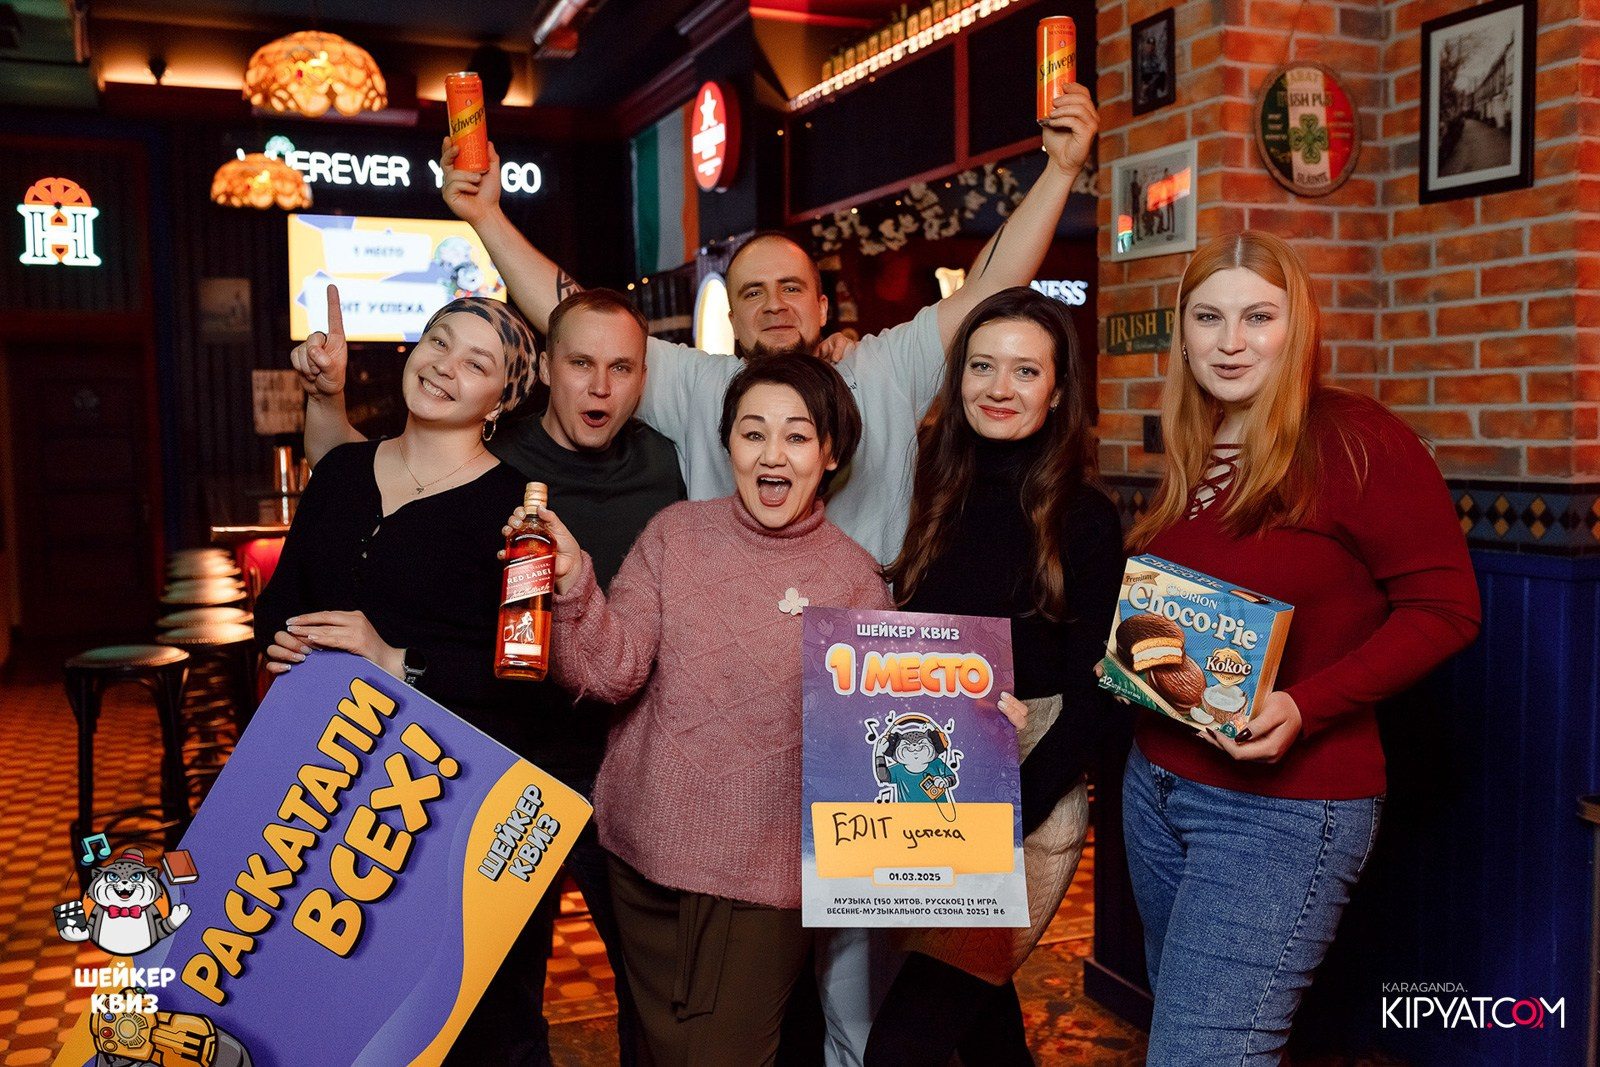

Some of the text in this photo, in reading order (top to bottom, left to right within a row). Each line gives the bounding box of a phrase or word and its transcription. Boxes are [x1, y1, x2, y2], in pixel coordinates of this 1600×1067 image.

[500, 161, 542, 194] GO
[1111, 312, 1157, 345] IRISH
[507, 574, 524, 585] RED
[526, 568, 551, 580] LABEL
[1125, 574, 1154, 583] Premium
[1179, 587, 1219, 610] ORION
[857, 622, 960, 641] ШЕЙКЕР КВИЗ
[828, 645, 992, 696] 1 МЕСТО
[180, 676, 398, 1006] РАСКАТАЛИ
[291, 722, 463, 958] ВСЕХ!
[478, 784, 544, 882] ШЕЙКЕР
[832, 811, 966, 849] EDIT успеха
[508, 813, 561, 883] КВИЗ
[888, 871, 942, 882] 01.03.2025
[826, 907, 931, 916] ВЕСЕННЕ-МУЗЫКАЛЬНОГО
[933, 908, 964, 916] СЕЗОНА
[966, 907, 989, 916] 2025]
[833, 897, 998, 906] МУЗЫКА [150 ХИТОВ. РУССКОЕ] [1 ИГРА
